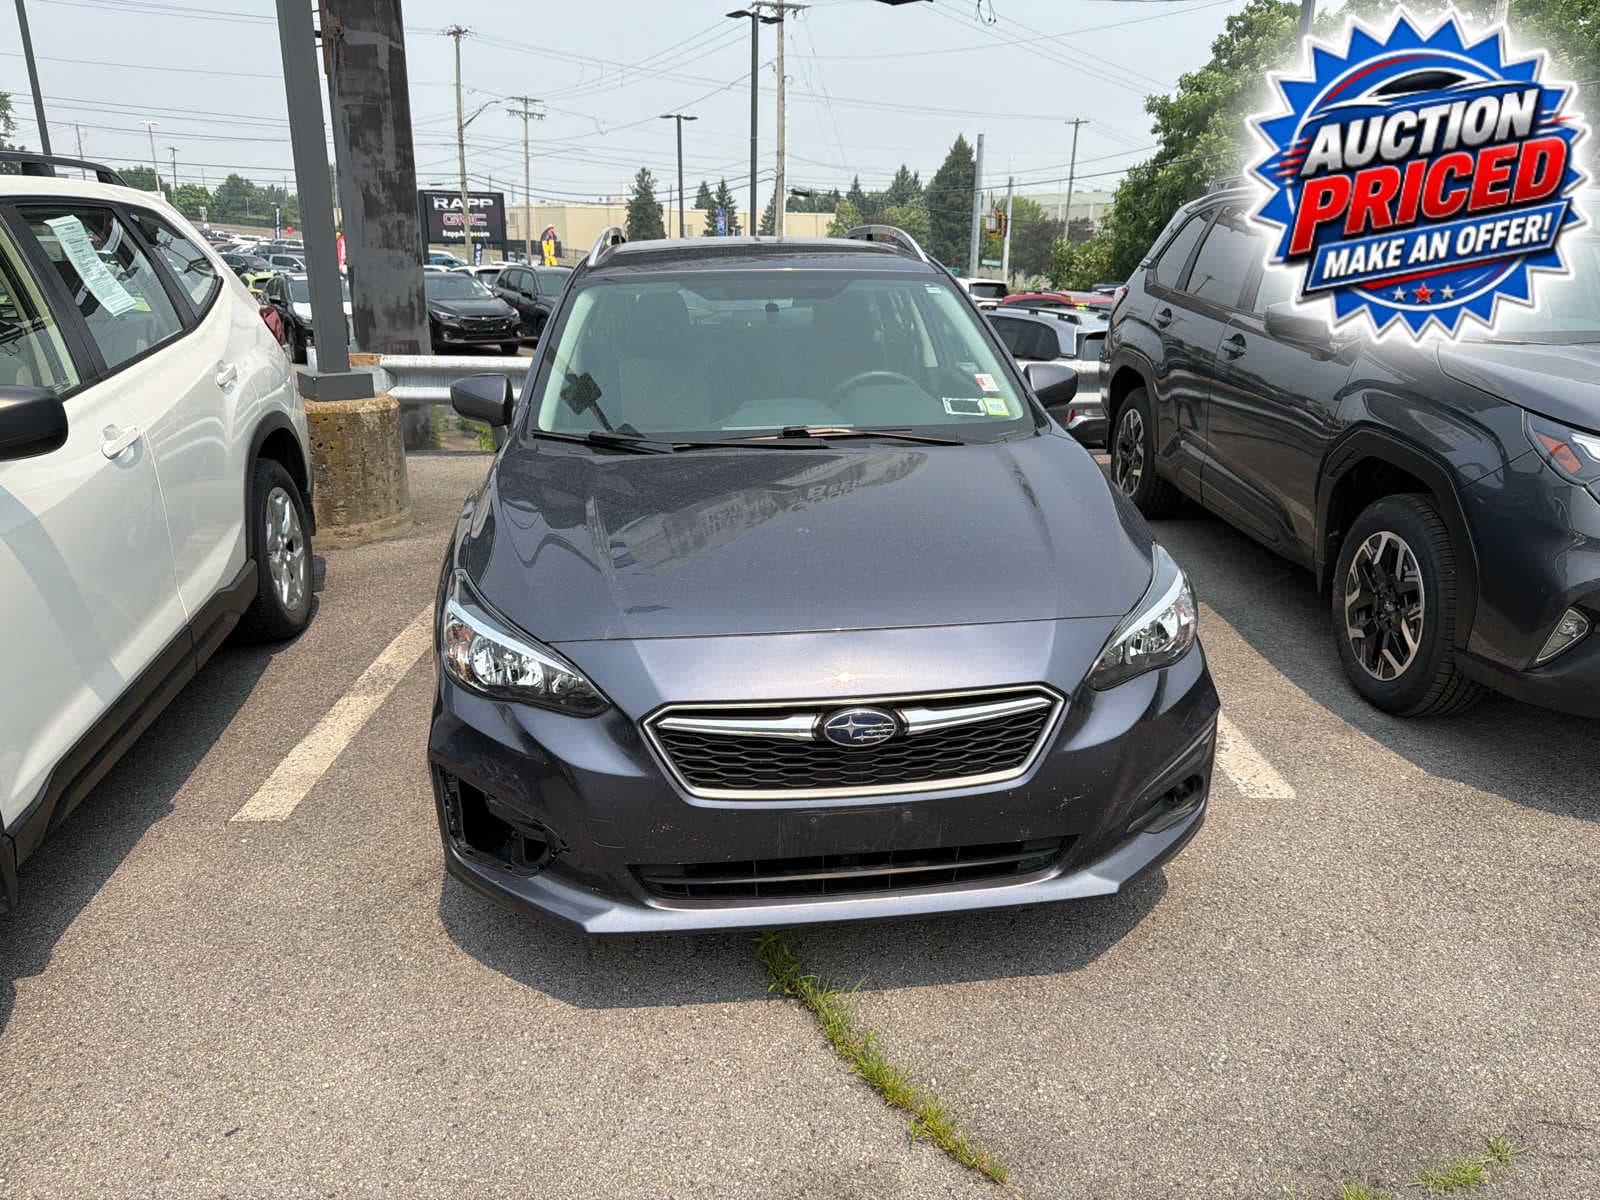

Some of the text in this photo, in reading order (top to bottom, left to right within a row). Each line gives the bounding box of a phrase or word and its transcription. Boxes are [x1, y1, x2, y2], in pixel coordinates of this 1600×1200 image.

[433, 197, 494, 209] RAPP
[443, 213, 488, 226] GMC
[442, 229, 491, 239] RappAo.com
